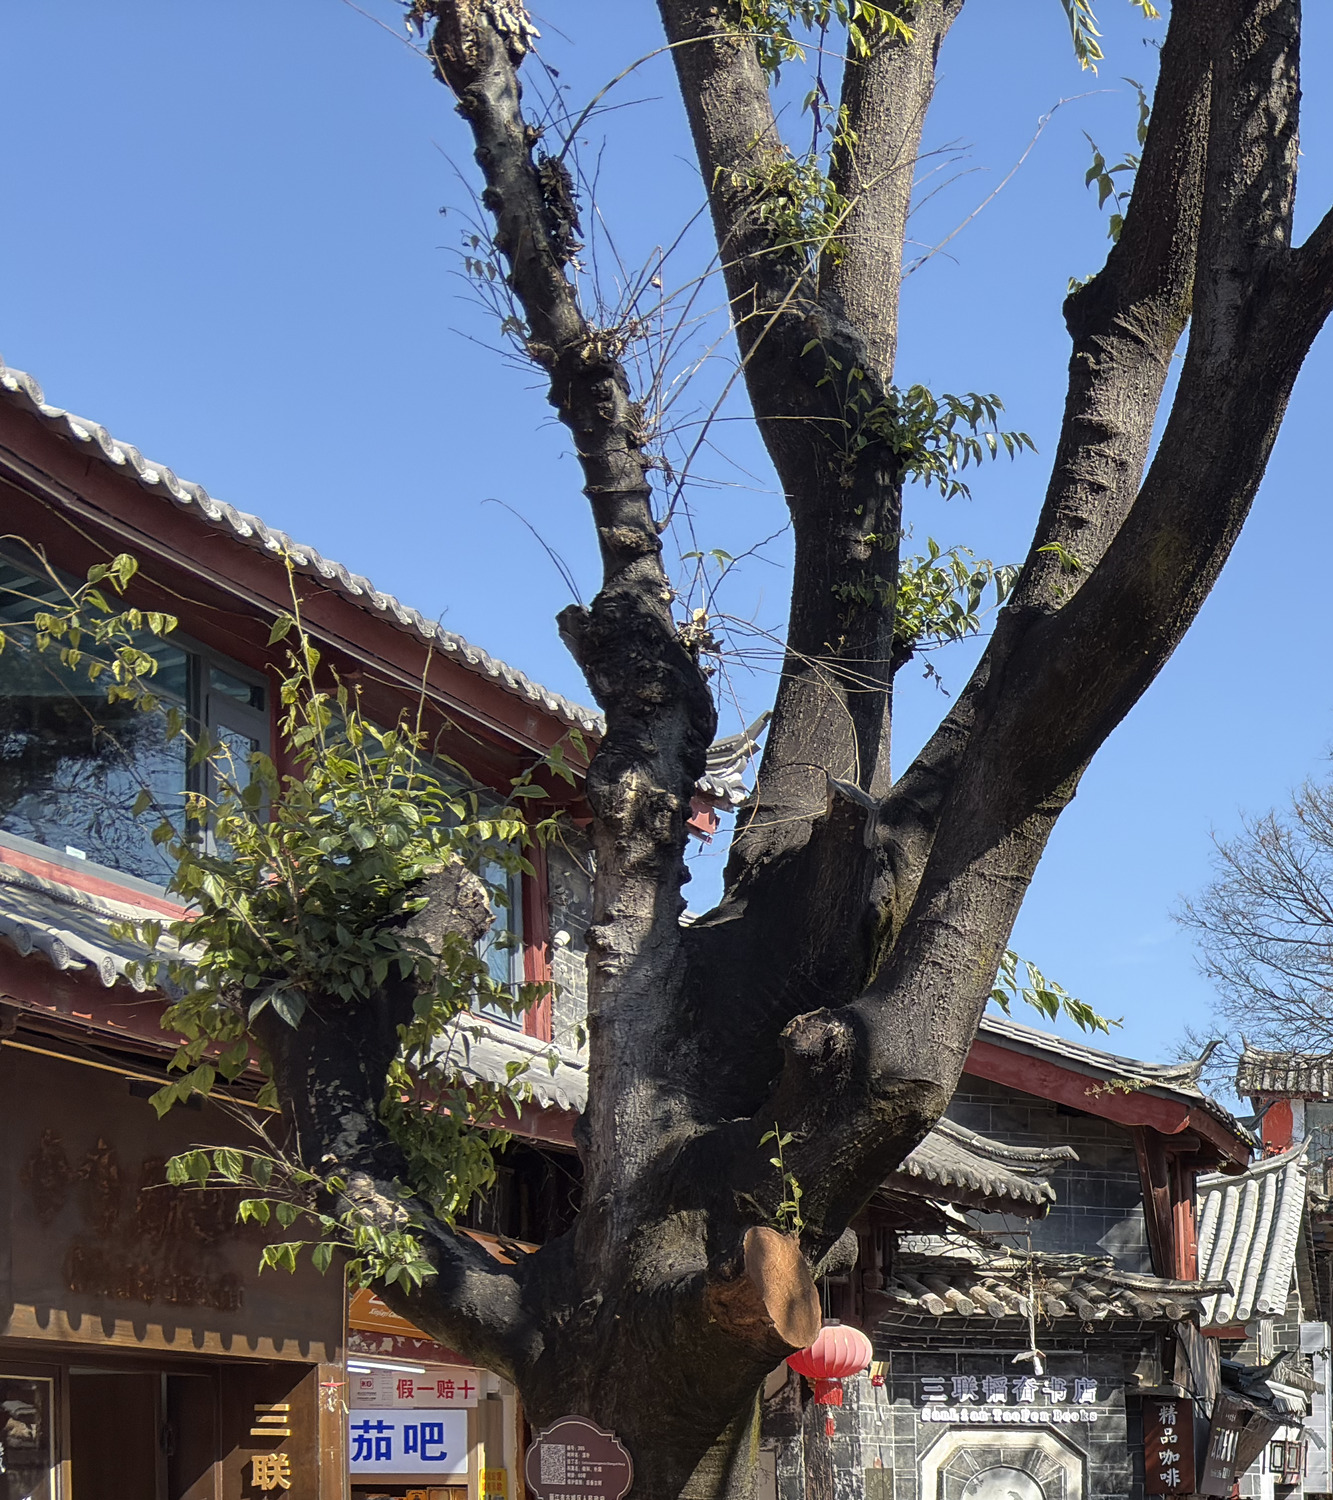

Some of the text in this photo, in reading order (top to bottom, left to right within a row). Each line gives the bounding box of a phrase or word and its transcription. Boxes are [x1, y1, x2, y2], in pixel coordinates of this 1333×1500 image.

[396, 1378, 476, 1400] 假一赔十
[921, 1375, 1098, 1404] 三联韬奋书店
[1052, 1409, 1098, 1422] Books
[350, 1419, 448, 1462] 茄吧
[1158, 1404, 1181, 1488] 精品咖啡
